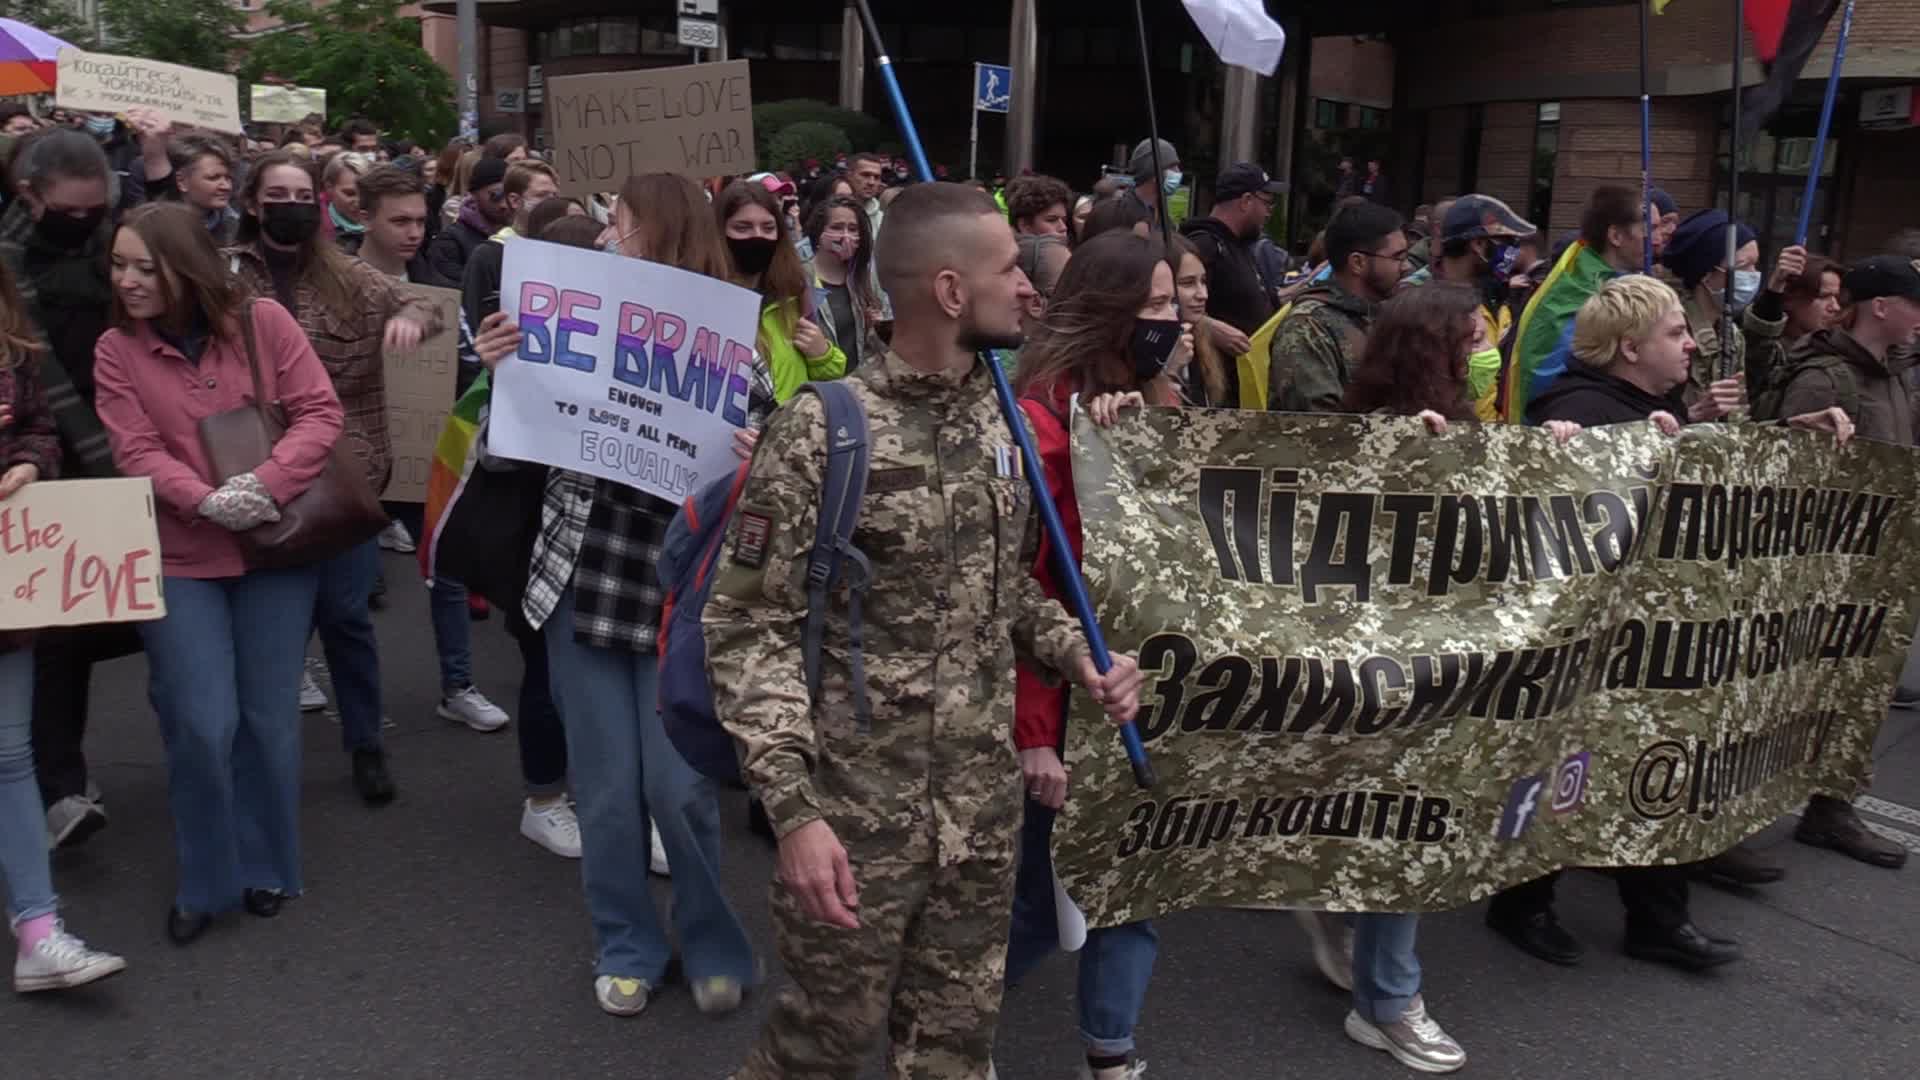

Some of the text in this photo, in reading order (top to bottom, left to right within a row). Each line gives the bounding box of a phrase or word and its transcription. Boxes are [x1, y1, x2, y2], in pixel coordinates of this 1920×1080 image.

[555, 76, 745, 129] MAKE LOVE
[567, 128, 745, 182] NOT WAR
[517, 280, 753, 428] BE BRAVE
[554, 401, 698, 459] TO LOVE ALL PEOPLE
[608, 387, 662, 417] ENOUGH
[580, 430, 699, 497] EQUALLY
[0, 507, 64, 554] the
[1199, 461, 1898, 605] Підтримай поранених
[14, 539, 156, 618] of LOVE
[1137, 627, 1592, 741] Захисників
[1586, 600, 1746, 692] нашої
[1117, 784, 1466, 858] Збір коштів:
